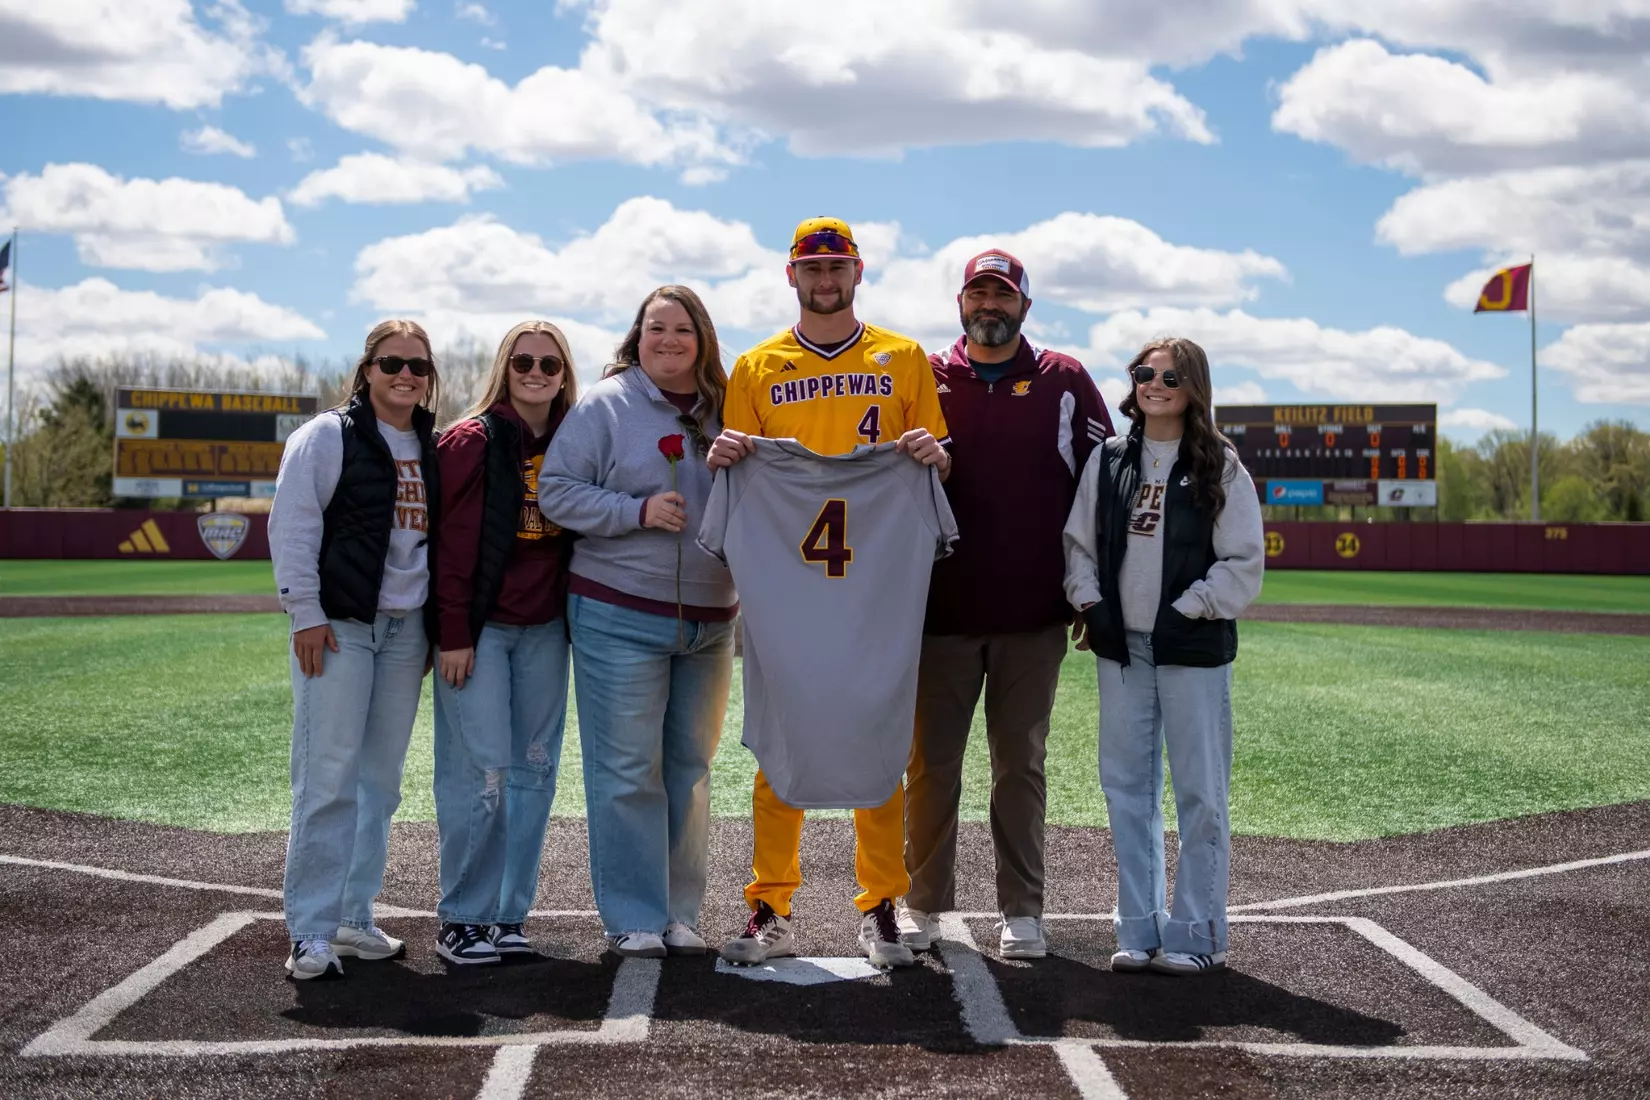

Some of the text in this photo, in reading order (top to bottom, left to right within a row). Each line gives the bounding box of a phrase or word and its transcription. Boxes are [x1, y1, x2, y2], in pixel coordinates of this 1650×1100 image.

[770, 374, 893, 406] CHIPPEWAS
[131, 390, 300, 413] CHIPPEWA BASEBALL
[1333, 407, 1374, 423] FIELD
[857, 404, 881, 444] 4
[1366, 424, 1382, 434] OUT
[1279, 432, 1289, 448] 0
[1325, 432, 1335, 448] 0
[1370, 432, 1380, 448] 0
[801, 498, 854, 579] 4
